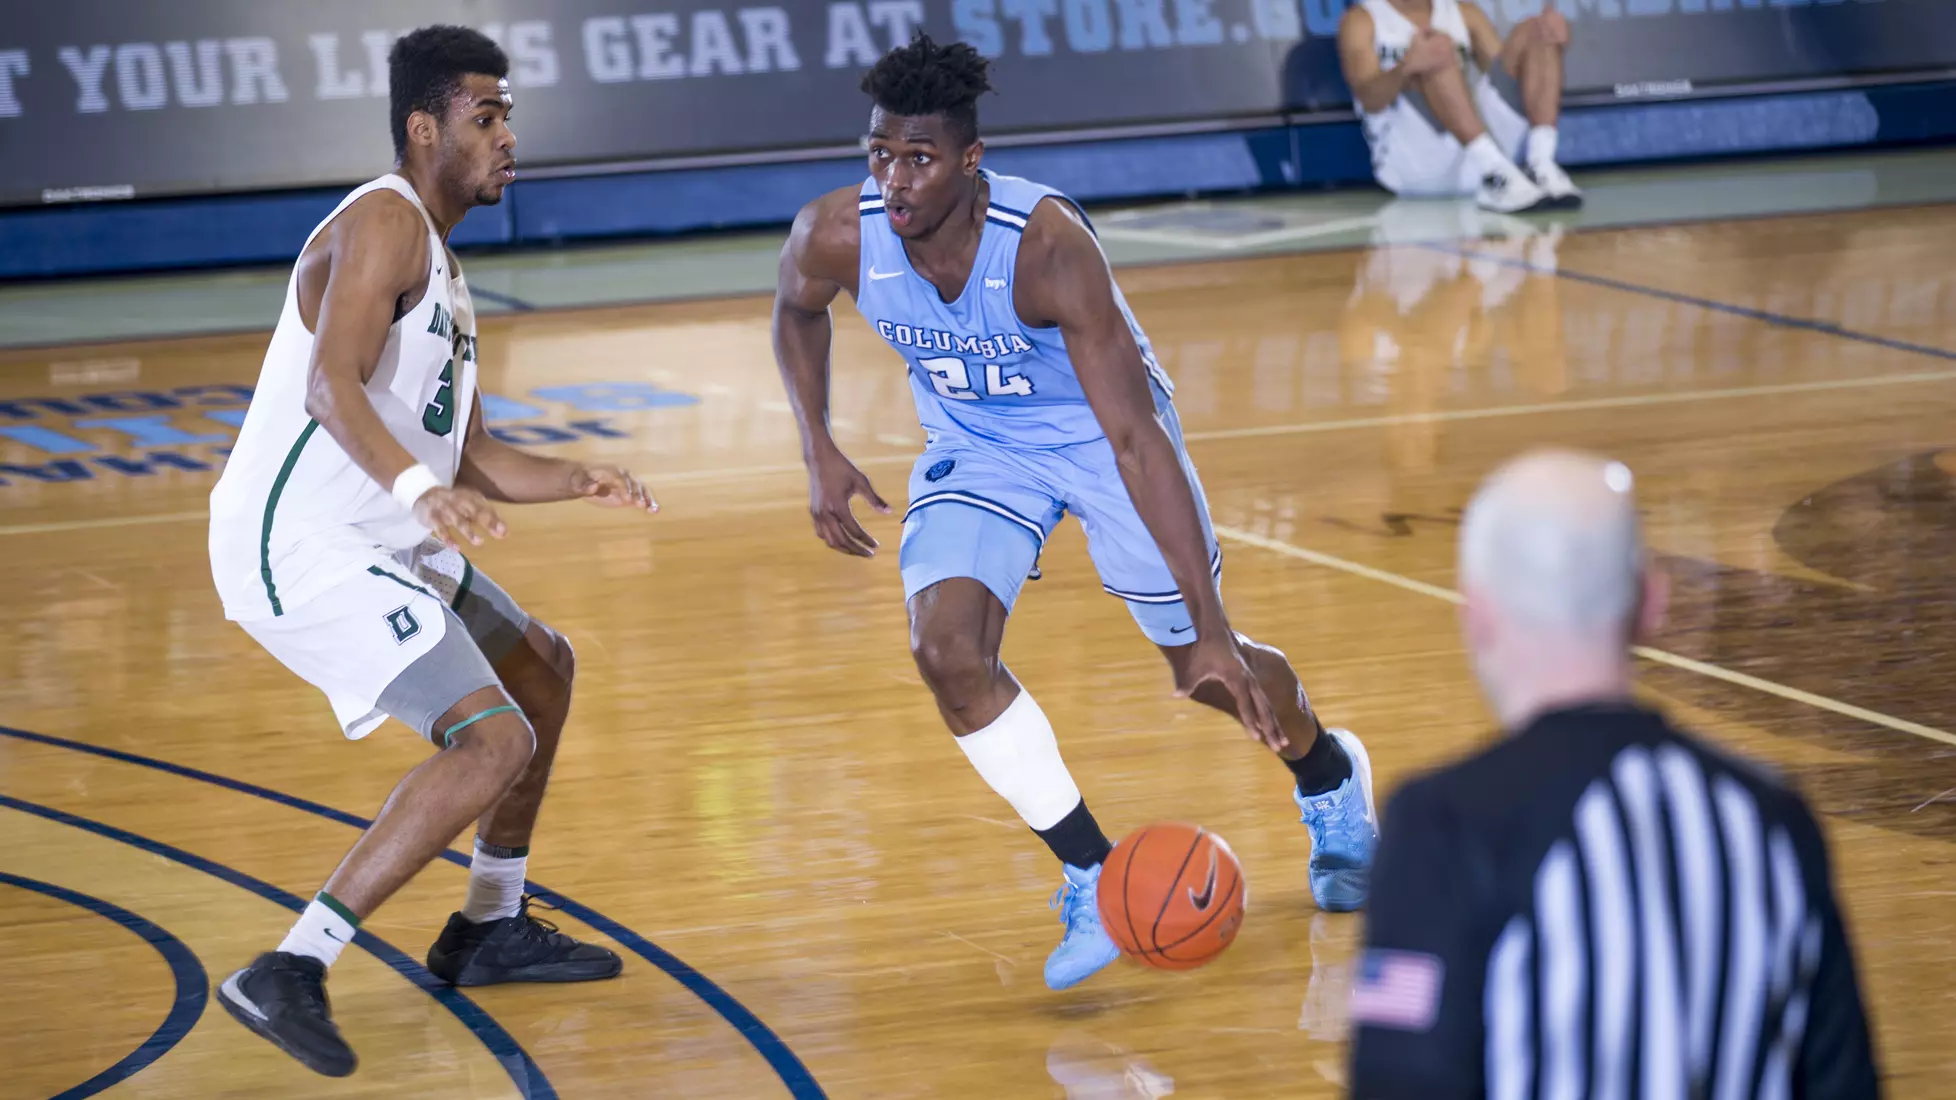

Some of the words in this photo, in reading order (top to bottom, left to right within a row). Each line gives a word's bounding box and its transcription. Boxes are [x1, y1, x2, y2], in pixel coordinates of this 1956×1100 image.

[57, 36, 290, 114] YOUR
[308, 20, 559, 99] LIS
[582, 6, 801, 83] GEAR
[824, 0, 924, 68] AT
[877, 319, 1033, 360] COLUMBIA
[422, 358, 454, 437] 3
[916, 356, 1036, 401] 24
[382, 604, 422, 646] D
